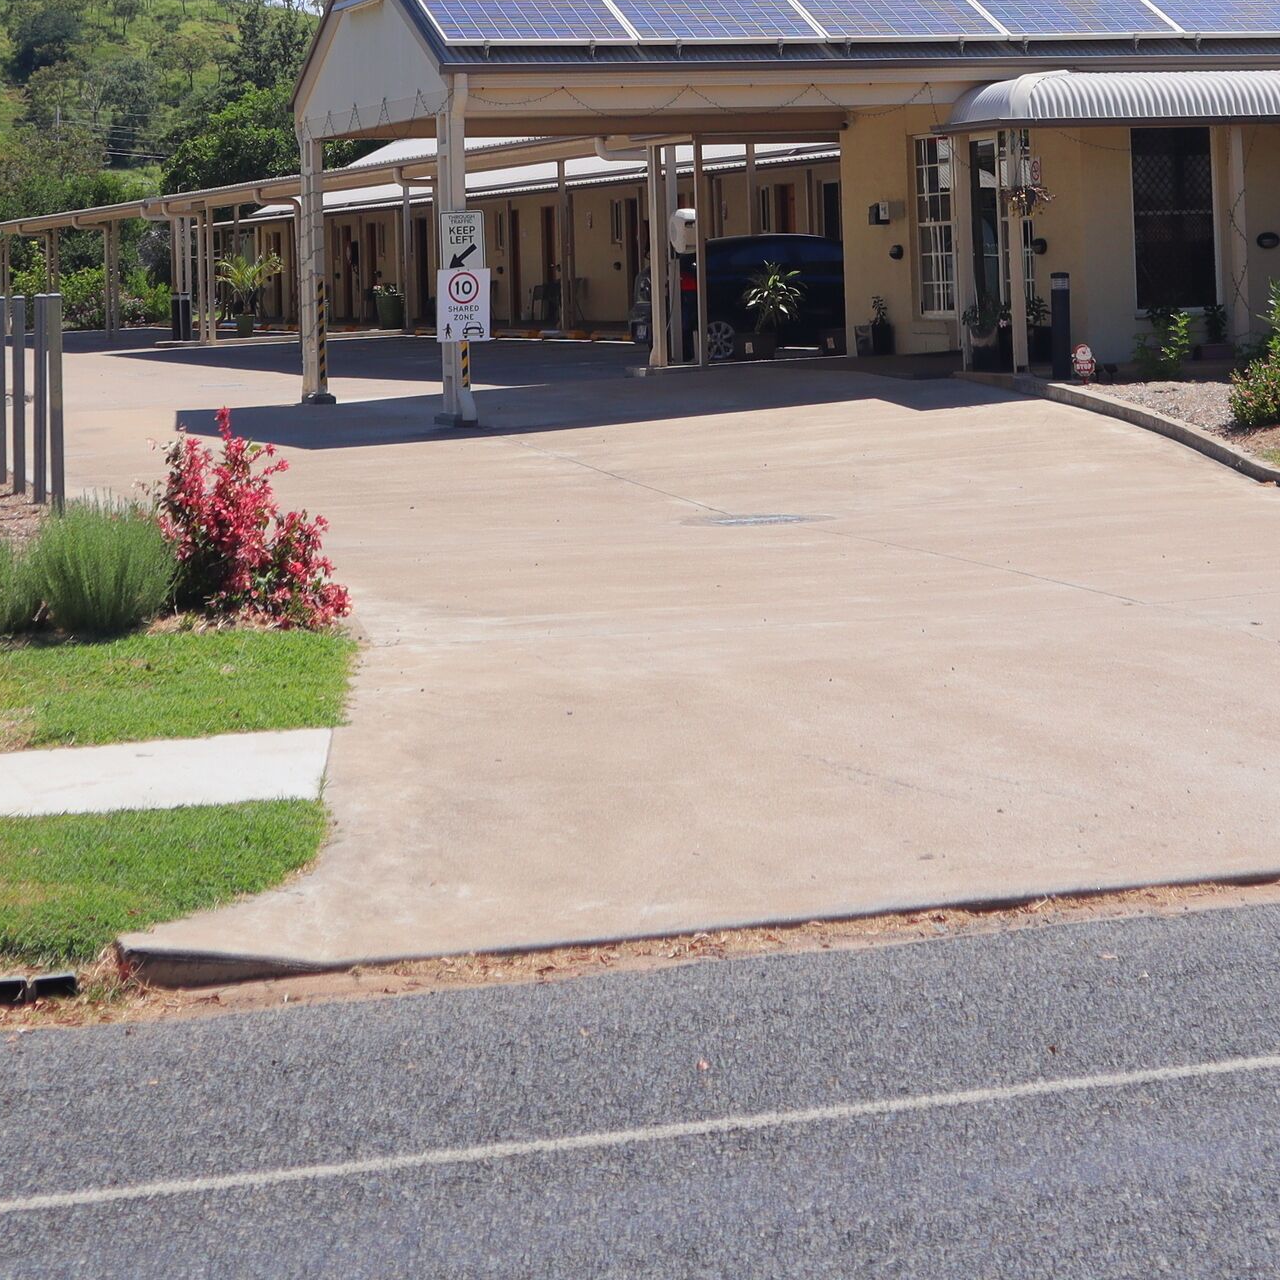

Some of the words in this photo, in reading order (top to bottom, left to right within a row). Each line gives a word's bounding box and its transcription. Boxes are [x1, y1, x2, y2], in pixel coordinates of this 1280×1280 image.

[448, 225, 476, 235] KEEP
[449, 235, 474, 245] LEFT
[454, 281, 473, 295] 10
[448, 305, 480, 313] SHARED
